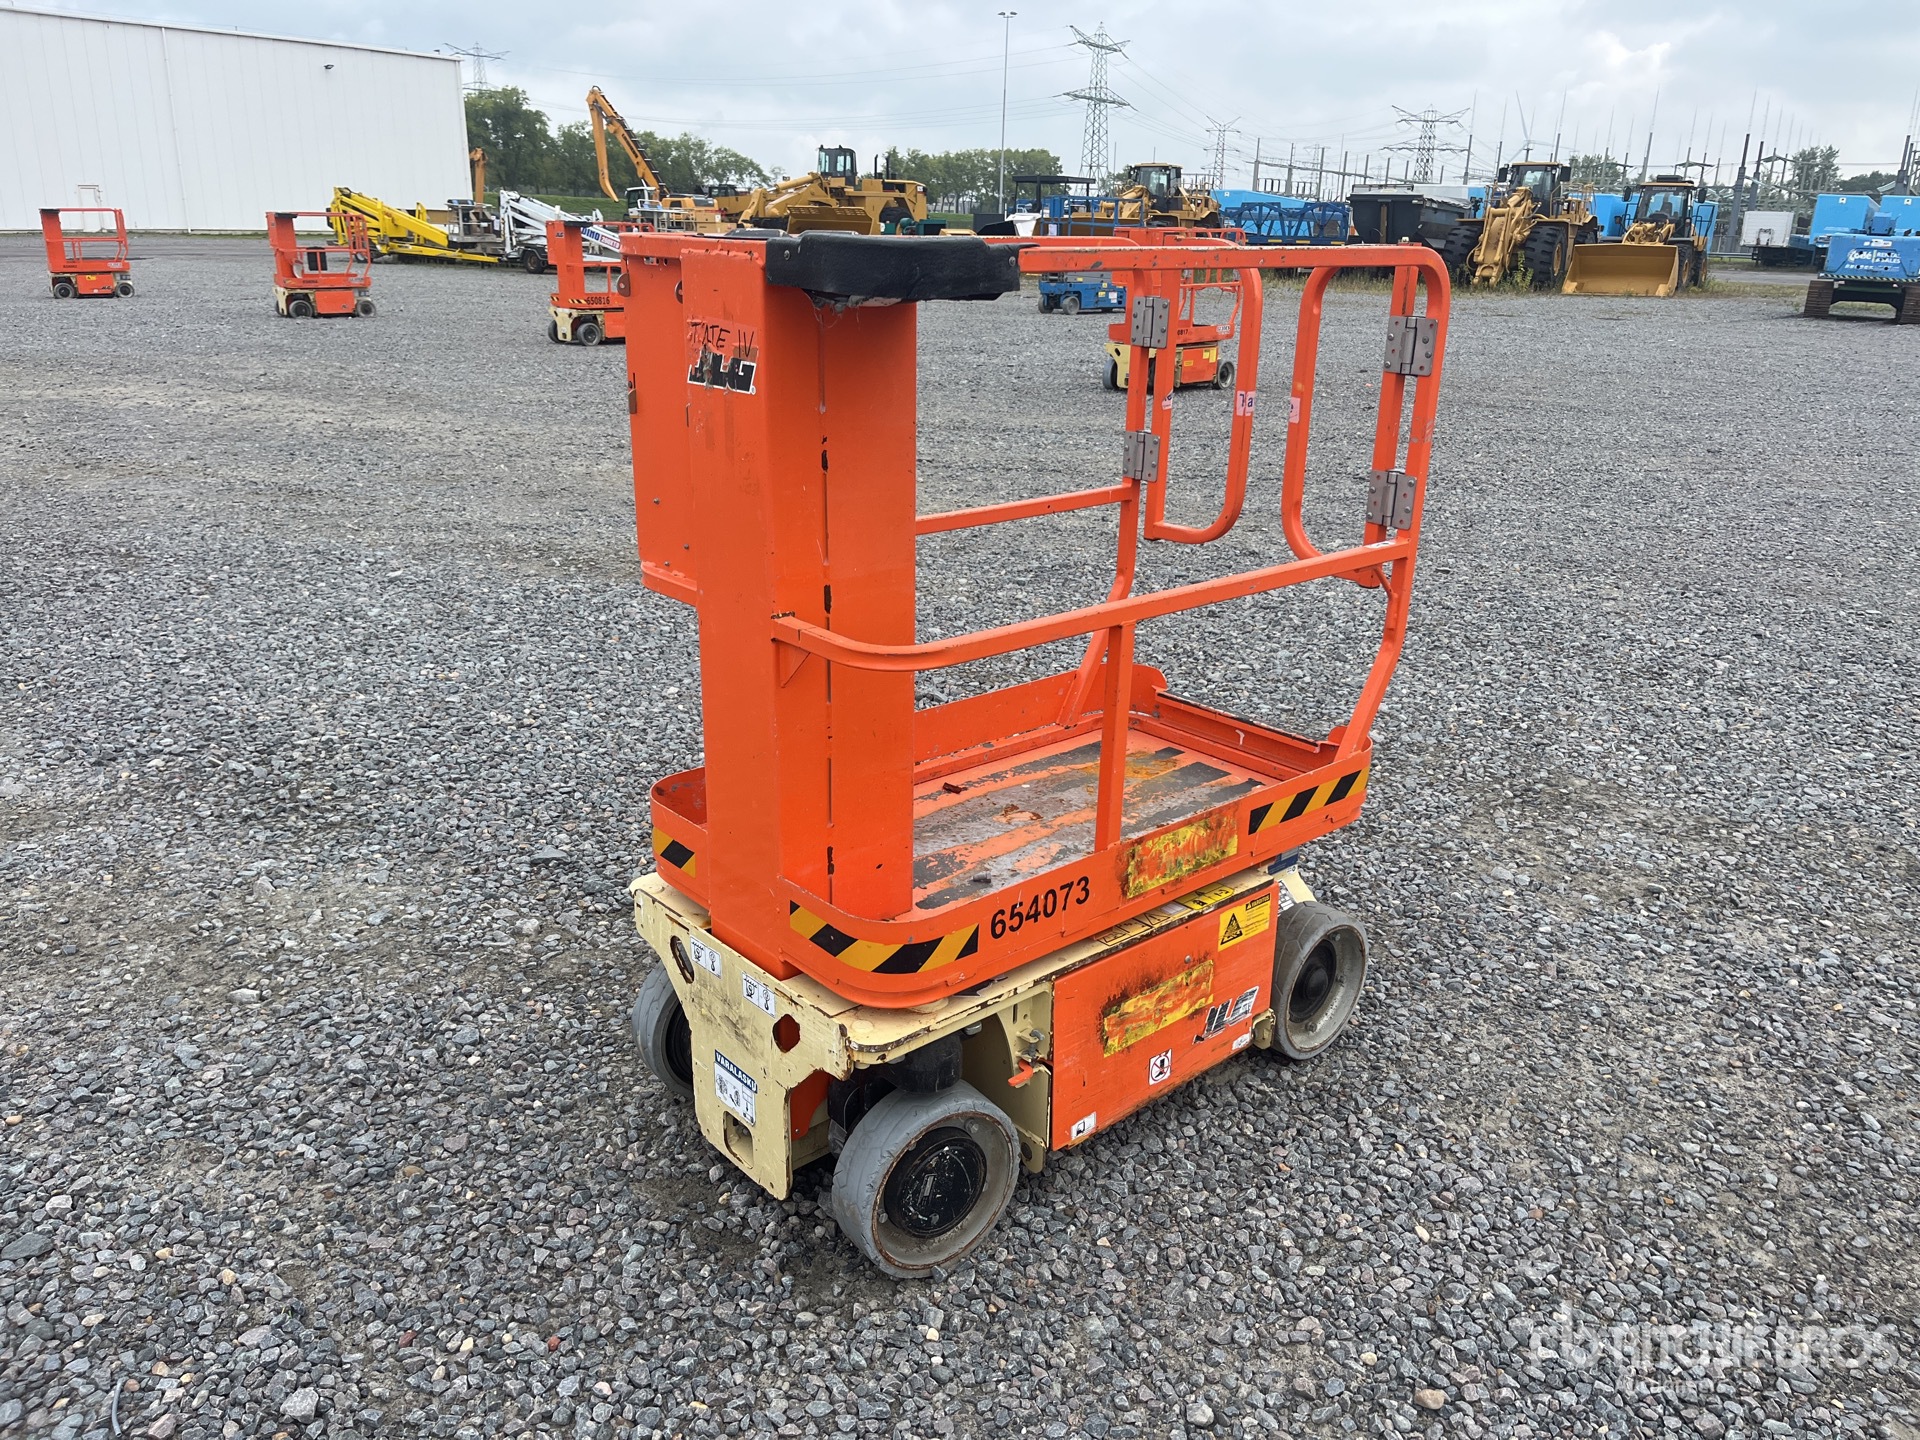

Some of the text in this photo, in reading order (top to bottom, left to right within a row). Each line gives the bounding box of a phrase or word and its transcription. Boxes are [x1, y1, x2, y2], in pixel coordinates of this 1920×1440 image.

[586, 296, 611, 305] 650816
[990, 875, 1091, 941] 654073
[715, 1053, 757, 1092] VARALASKU
